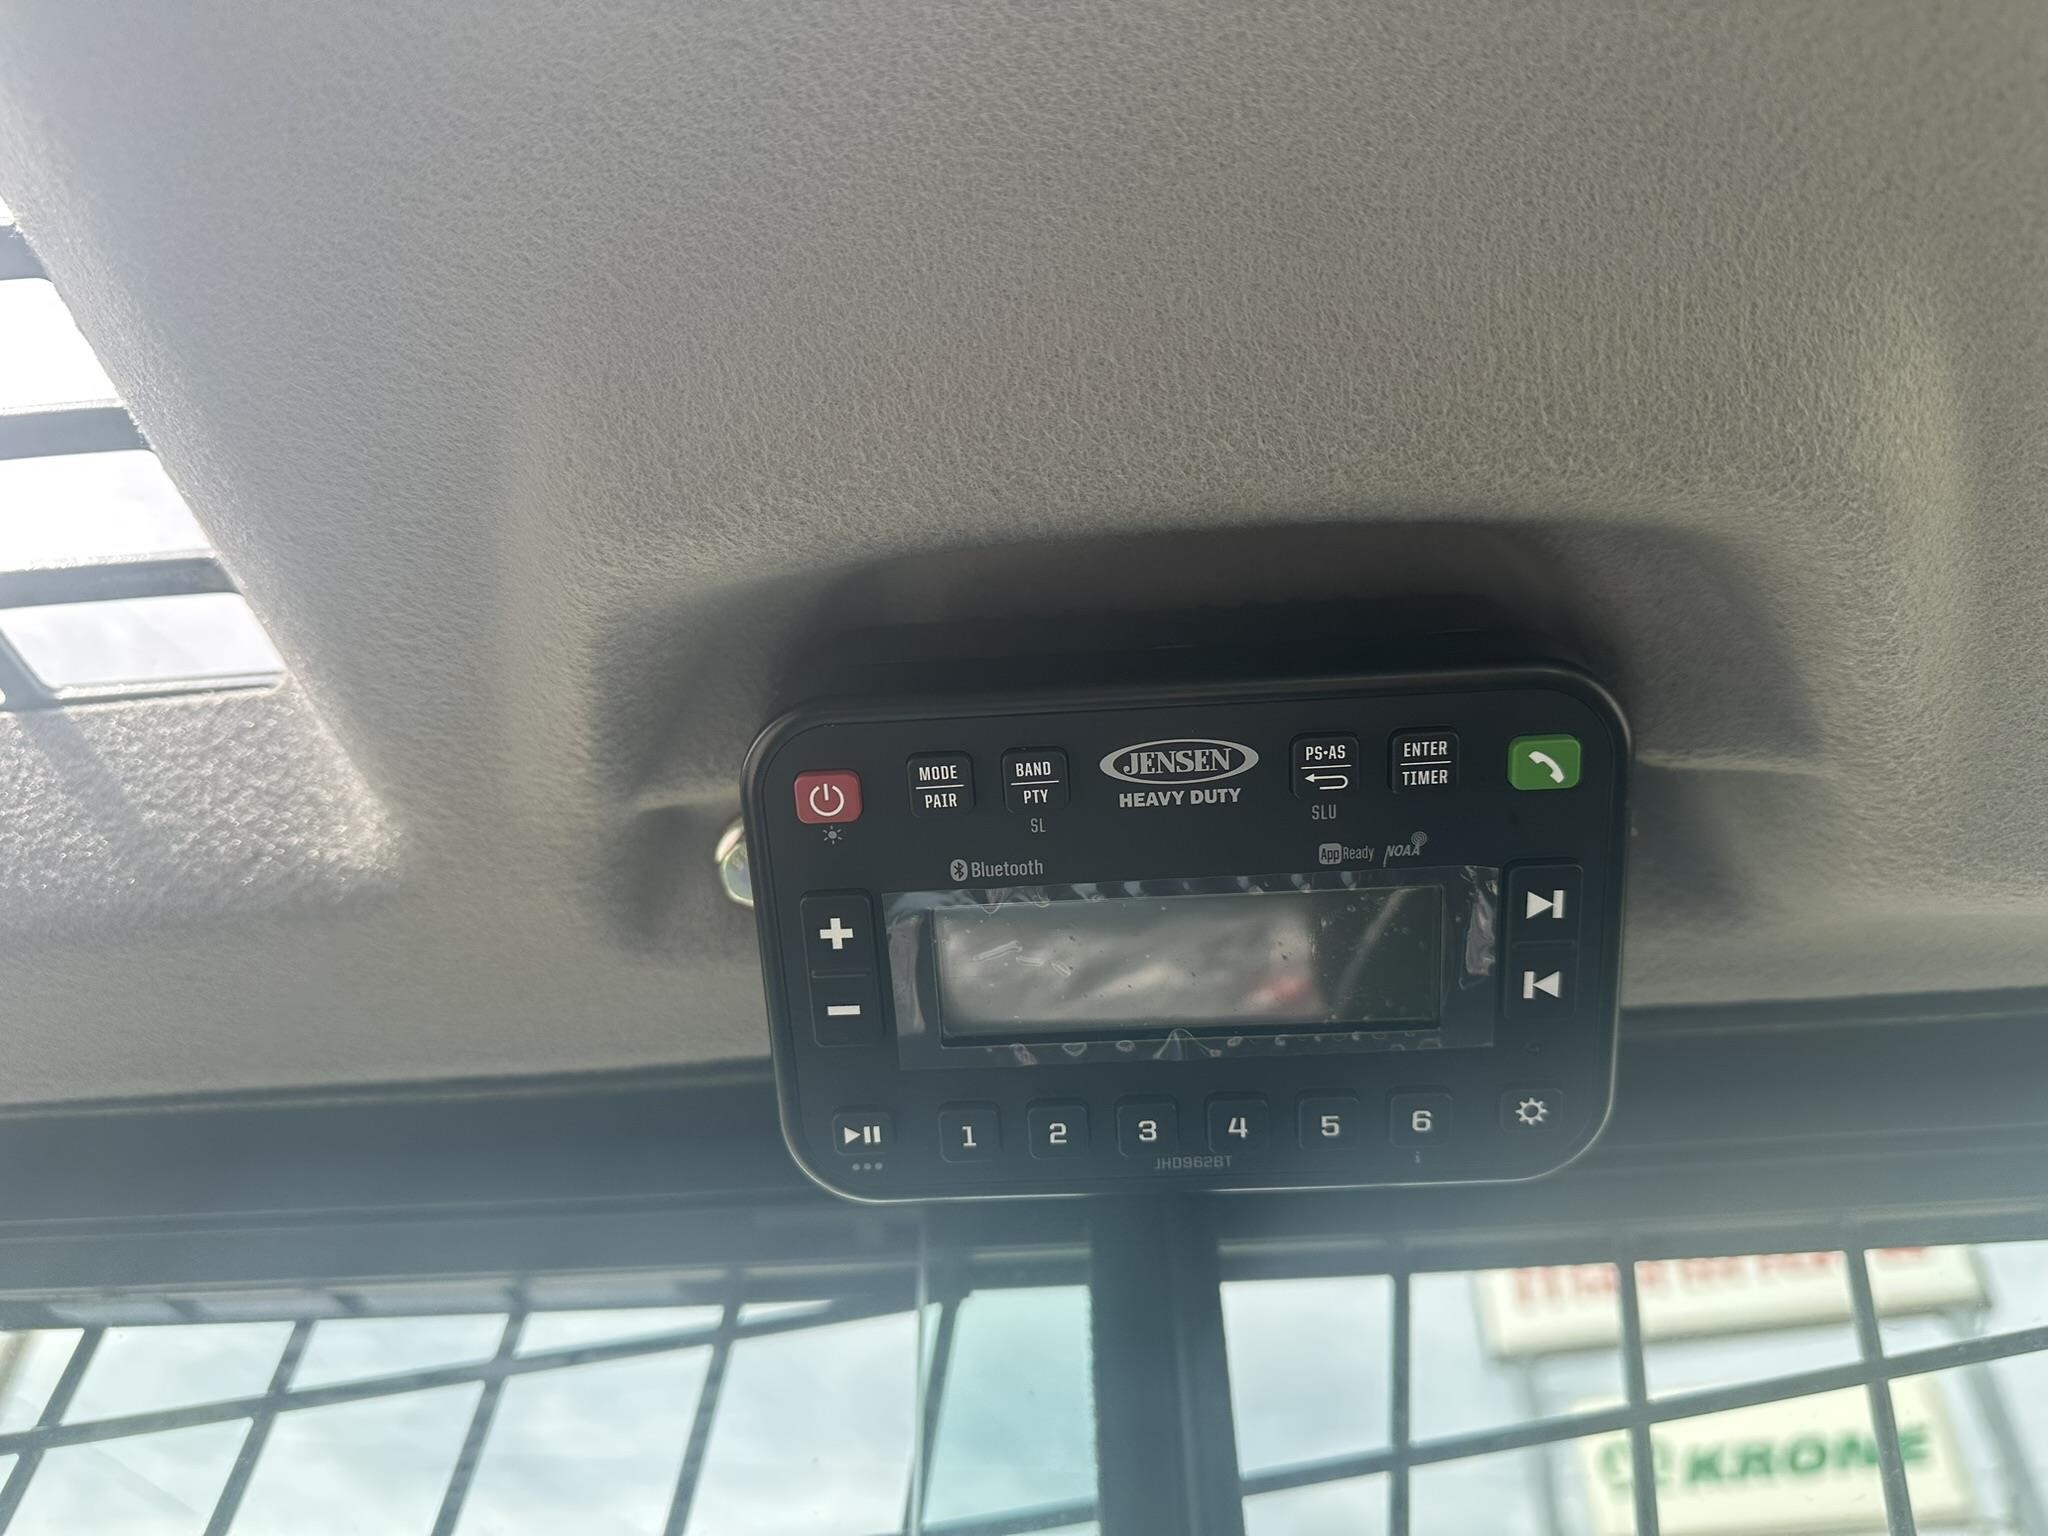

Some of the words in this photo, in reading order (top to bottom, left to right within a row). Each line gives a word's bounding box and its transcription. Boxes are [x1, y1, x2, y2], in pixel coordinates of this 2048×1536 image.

[1402, 740, 1448, 758] ENTER
[1015, 761, 1051, 777] BAND
[1122, 747, 1232, 776] JENSEN
[918, 764, 958, 781] MODE
[1401, 769, 1449, 786] TIMER
[924, 793, 958, 809] PAIR
[1023, 788, 1049, 804] PTY
[1118, 790, 1185, 808] HEAVY
[1190, 787, 1242, 805] DUTY
[1311, 804, 1337, 820] SLU
[1030, 818, 1047, 834] SL
[1382, 844, 1421, 868] NOAA
[970, 860, 1044, 879] Bluetooth
[1138, 1119, 1158, 1142] 3
[1227, 1116, 1249, 1138] 4
[1320, 1115, 1340, 1137] 5
[1411, 1109, 1432, 1132] 6
[961, 1125, 978, 1148] 1
[1048, 1122, 1068, 1145] 2
